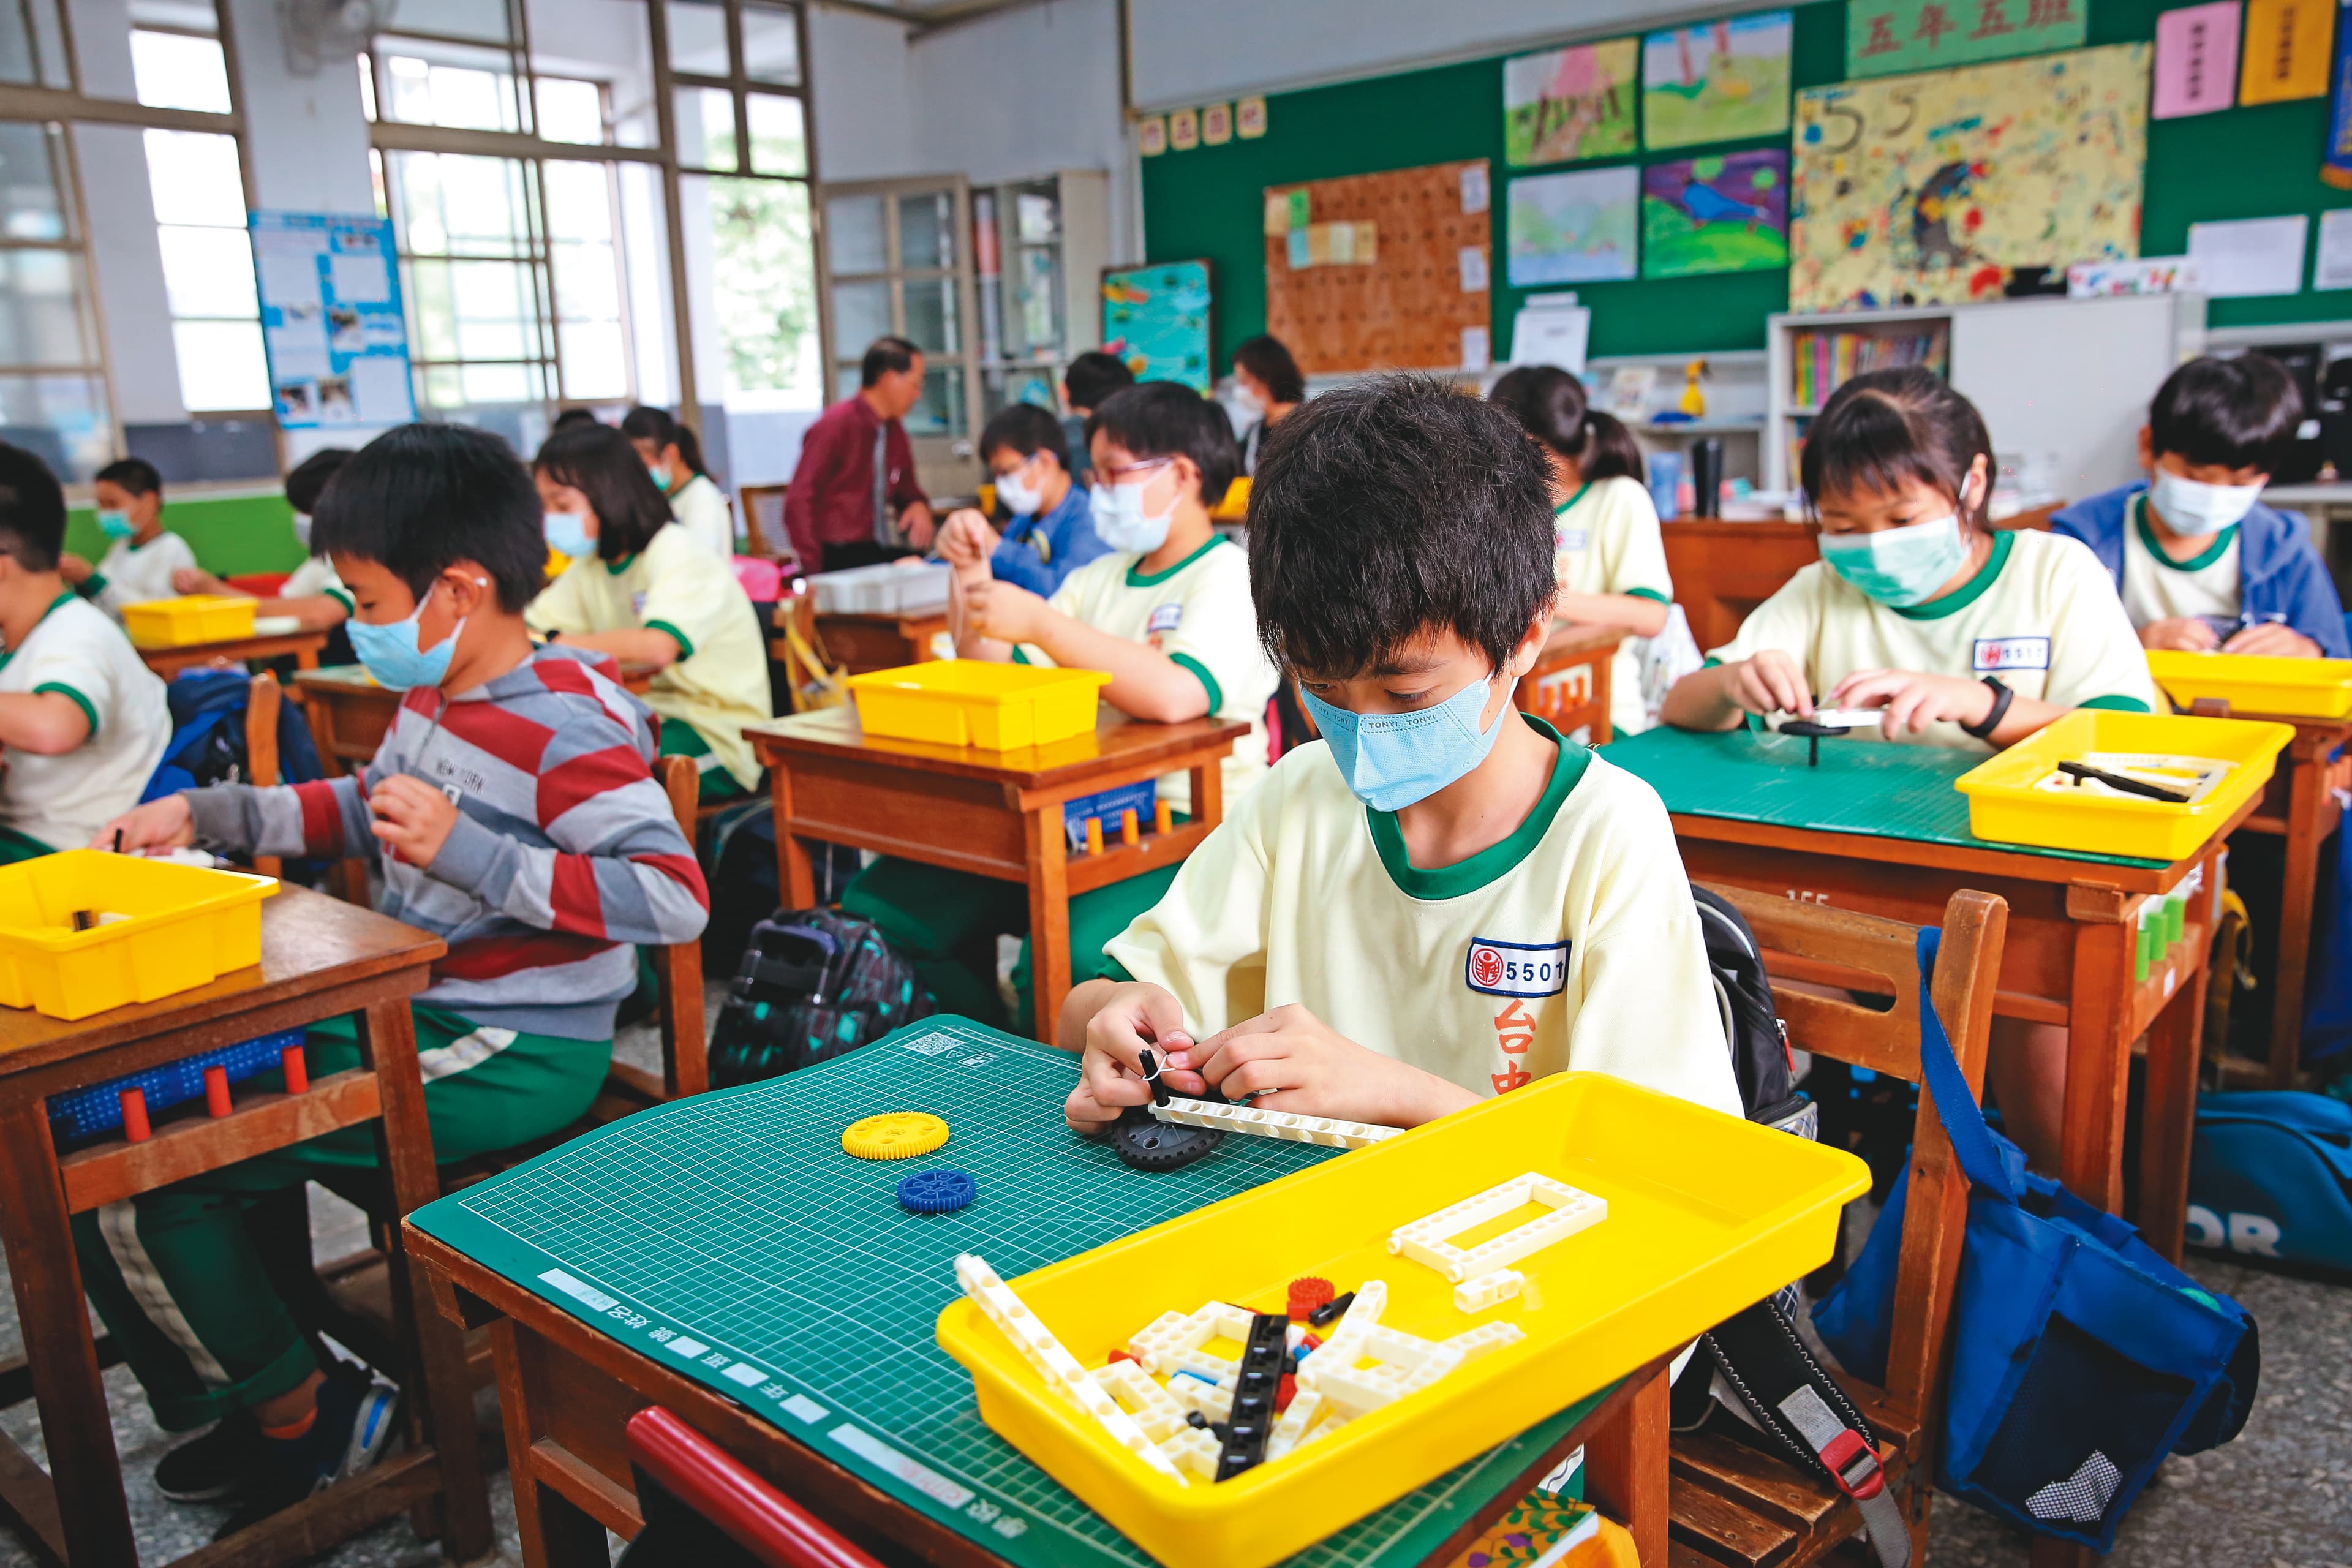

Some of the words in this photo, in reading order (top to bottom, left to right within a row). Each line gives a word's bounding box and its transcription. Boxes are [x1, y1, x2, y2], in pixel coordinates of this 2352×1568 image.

[1858, 0, 2078, 58] 五年五班
[1333, 714, 1351, 726] TONYI
[1406, 715, 1436, 726] TONYI
[1506, 960, 1564, 981] 5501
[606, 1305, 652, 1329] 姓名
[648, 1327, 677, 1343] 號
[701, 1352, 732, 1368] 班
[760, 1382, 789, 1400] 年
[965, 1499, 1028, 1539] 學校
